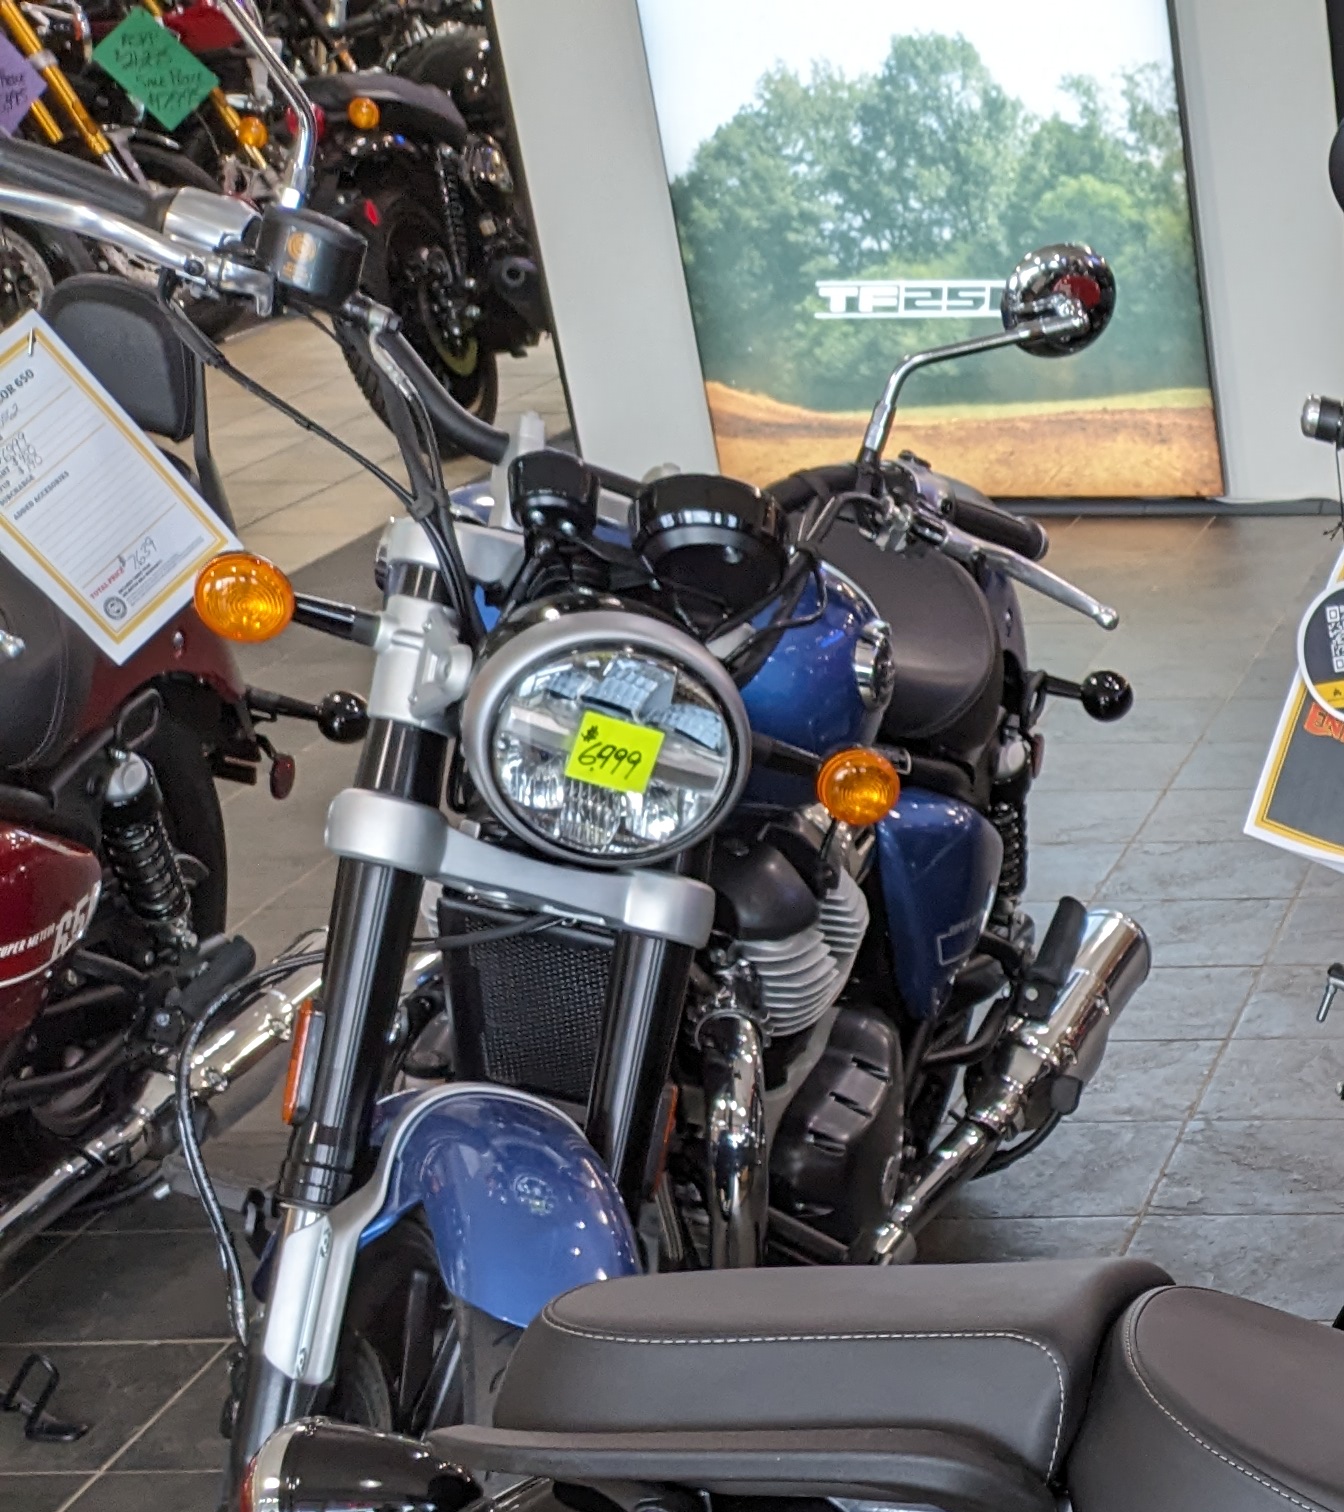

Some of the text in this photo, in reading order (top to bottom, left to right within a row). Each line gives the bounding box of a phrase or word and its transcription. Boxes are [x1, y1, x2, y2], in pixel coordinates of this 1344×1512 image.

[816, 282, 1006, 316] TF25
[14, 368, 35, 388] 650
[89, 580, 110, 600] TOTAL
[107, 564, 127, 586] PRICE
